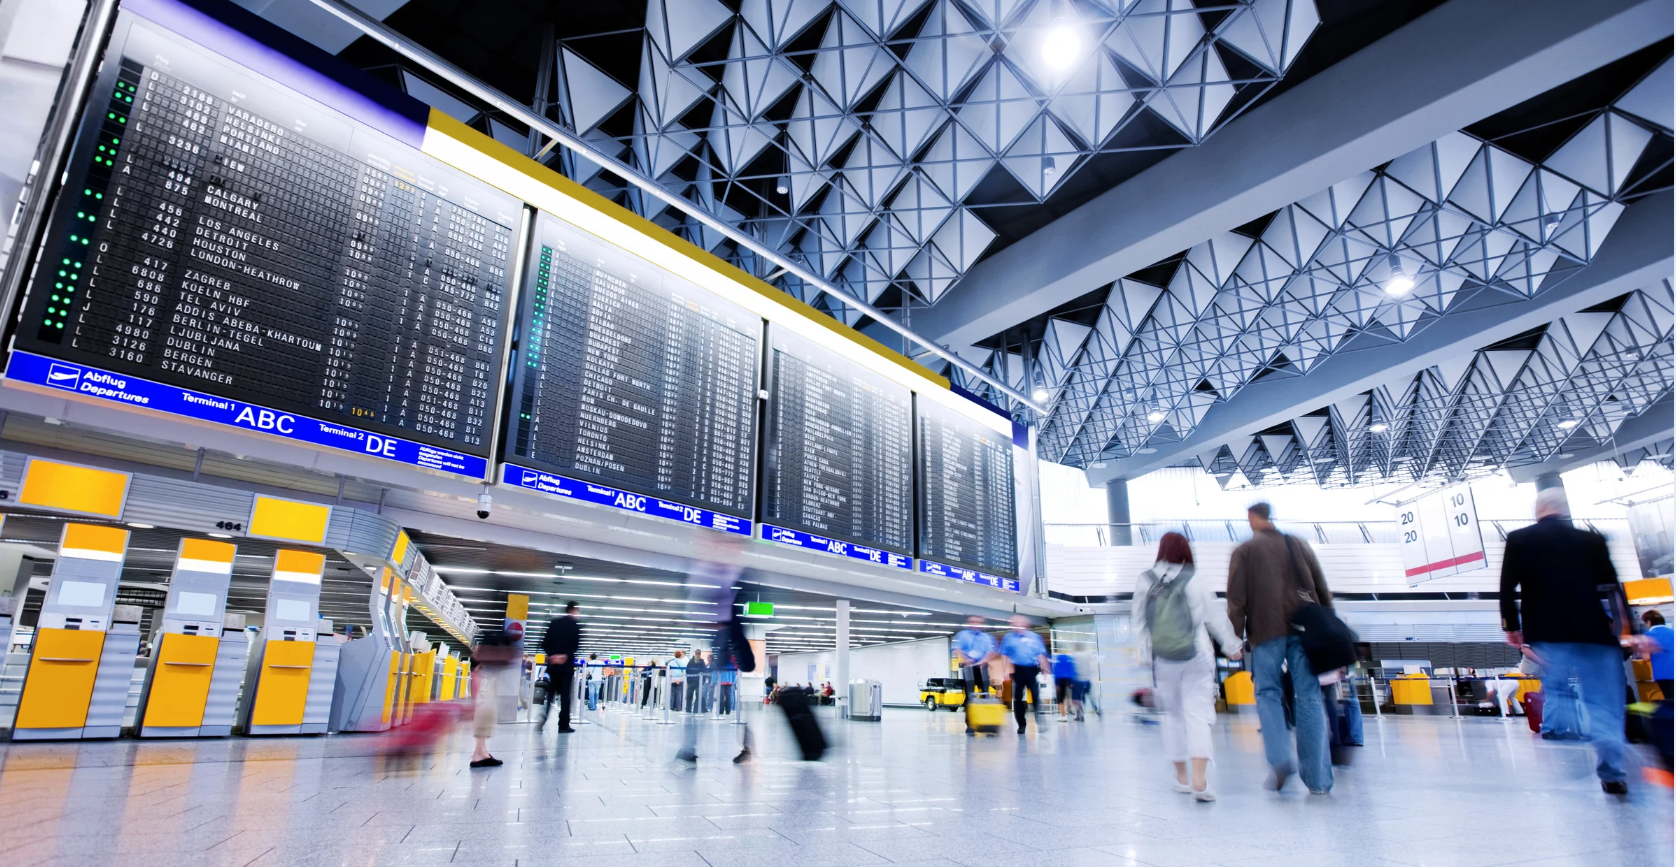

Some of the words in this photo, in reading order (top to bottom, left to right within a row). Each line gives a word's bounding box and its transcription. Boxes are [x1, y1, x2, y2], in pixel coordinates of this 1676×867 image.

[180, 96, 210, 115] 3102
[225, 116, 281, 146] HELSINKI
[183, 86, 213, 105] 2188
[228, 106, 283, 136] VARADERO
[183, 119, 205, 134] 462
[220, 135, 256, 156] MIAMI
[185, 109, 208, 124] 468
[223, 125, 279, 155] PORTLAND
[169, 136, 200, 154] 3236
[215, 154, 244, 172] IEW
[165, 180, 189, 195] 875
[204, 195, 263, 223] MONTREAL
[168, 170, 192, 185] 494
[207, 185, 258, 210] CALGARY
[153, 223, 178, 238] 440
[194, 237, 246, 261] HOUSTON
[156, 212, 180, 227] 442
[196, 226, 249, 250] DETROIT
[159, 201, 183, 216] 456
[199, 216, 222, 230] LOS
[229, 226, 279, 250] ANGELES
[142, 231, 175, 249] 4726
[191, 247, 300, 290] LONDON-HEATHROW
[144, 256, 169, 271] 417
[185, 269, 232, 290] ZAGREB
[132, 265, 166, 282] 6808
[182, 280, 221, 299] KOELN
[229, 294, 251, 308] HBF
[138, 279, 163, 293] 686
[179, 291, 203, 305] TEL
[211, 301, 241, 316] AVIV
[128, 314, 153, 328] 117
[170, 325, 241, 351] LJUBLJANA
[131, 302, 156, 316] 176
[173, 314, 266, 346] BERLIN-TEGEL
[134, 290, 160, 305] 590
[176, 302, 216, 321] ADDIS
[224, 316, 323, 351] ABEBA-KHARTOUM
[112, 335, 147, 352] 3126
[164, 348, 213, 368] BERGEN
[115, 323, 150, 340] 4980
[167, 337, 216, 356] DUBLIN
[83, 371, 126, 389] Abflug
[108, 348, 144, 364] 3160
[161, 360, 234, 385] STAVANGER
[80, 381, 149, 404] Departures
[182, 392, 228, 410] Terminal
[230, 403, 235, 411] 1
[235, 406, 295, 435] ABC
[579, 420, 608, 433] VILNIUS
[319, 423, 361, 440] Terminal
[365, 435, 398, 458] DE
[578, 428, 607, 442] TORONTO
[539, 474, 560, 486] Abflug
[575, 462, 600, 474] DUBLIN
[538, 482, 572, 496] Departures
[587, 485, 611, 496] Terminal
[614, 492, 646, 511] ABC
[1450, 493, 1464, 507] 10
[216, 521, 241, 531] 464
[658, 501, 679, 511] Terminal
[684, 507, 702, 524] DE
[1401, 511, 1414, 525] 20
[1454, 513, 1468, 526] 10
[827, 541, 847, 555] ABC
[1404, 530, 1417, 543] 20
[869, 549, 881, 562] DE
[962, 570, 975, 581] ABC
[990, 577, 998, 586] DE
